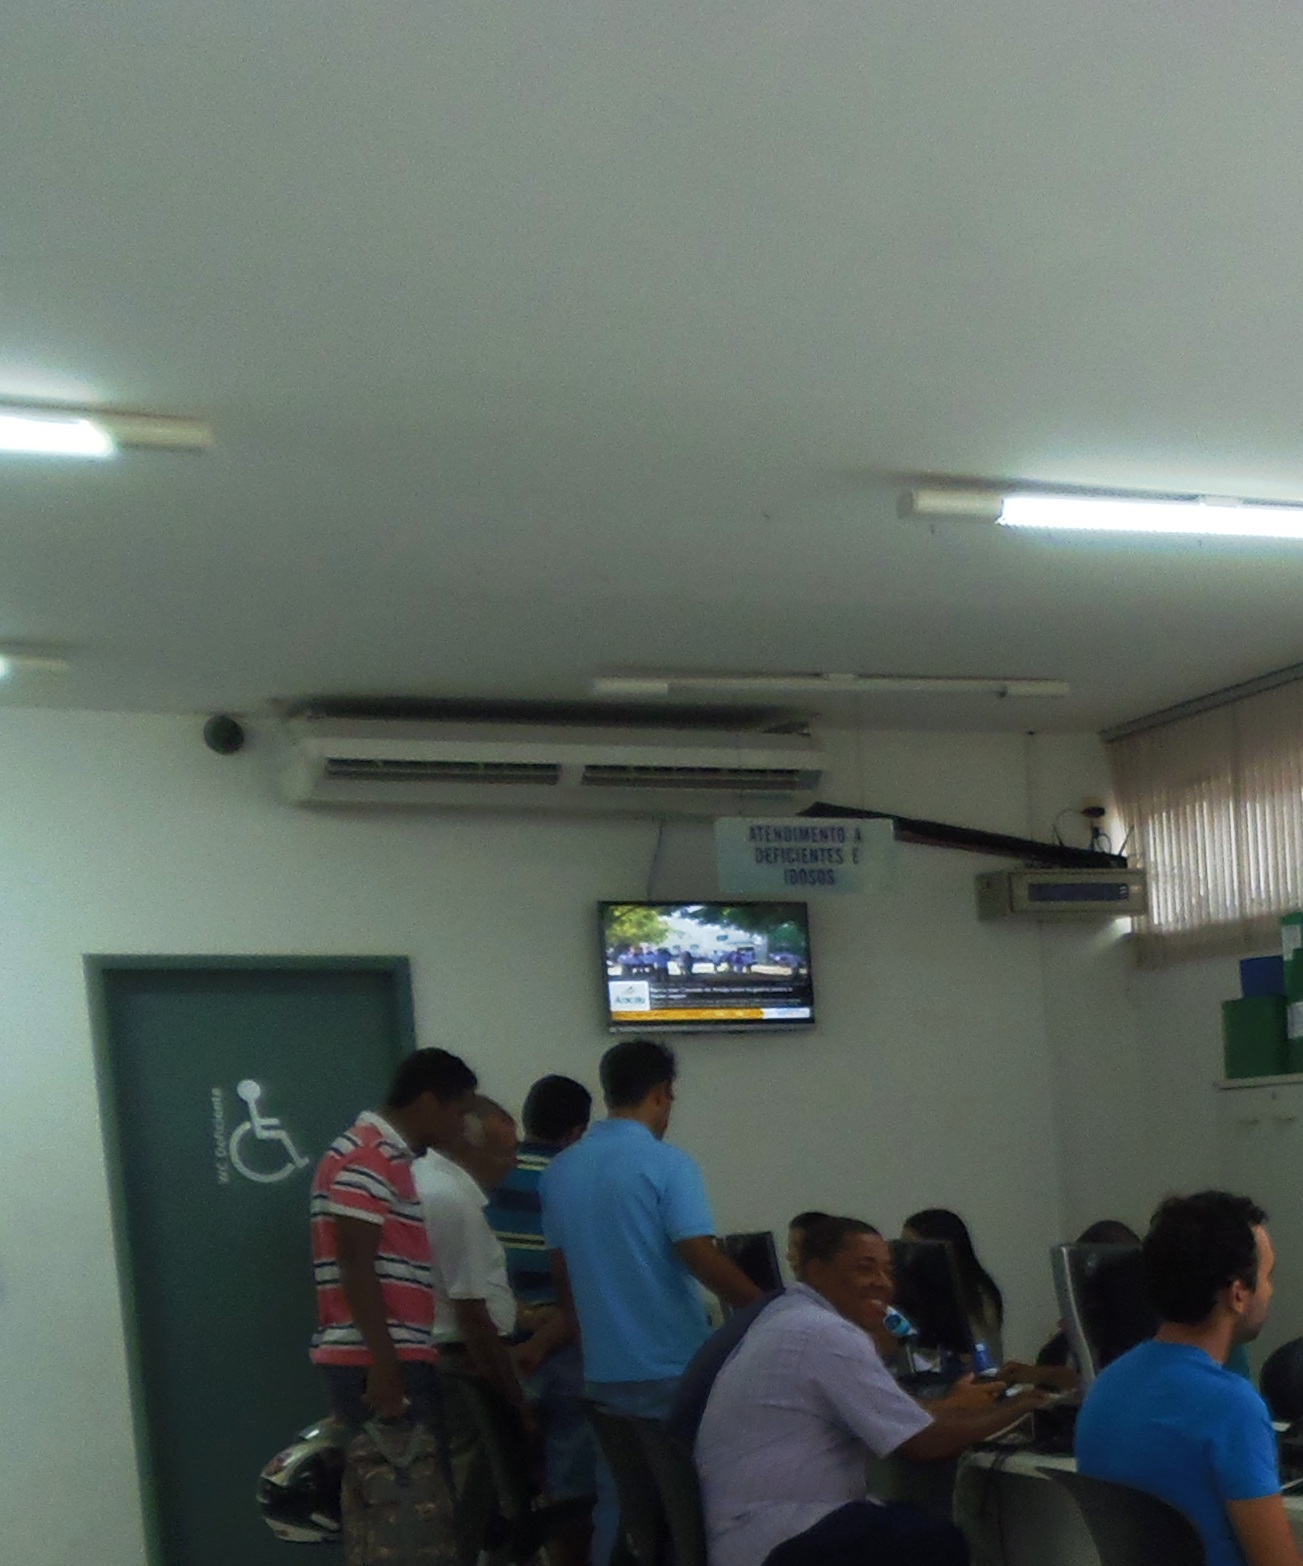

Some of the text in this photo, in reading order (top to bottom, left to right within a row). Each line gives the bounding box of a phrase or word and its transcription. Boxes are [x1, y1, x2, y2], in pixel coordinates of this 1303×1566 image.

[749, 825, 846, 843] ATENDIMENTO
[755, 847, 860, 864] DEFICIENTES E
[783, 868, 836, 886] IDOSOS
